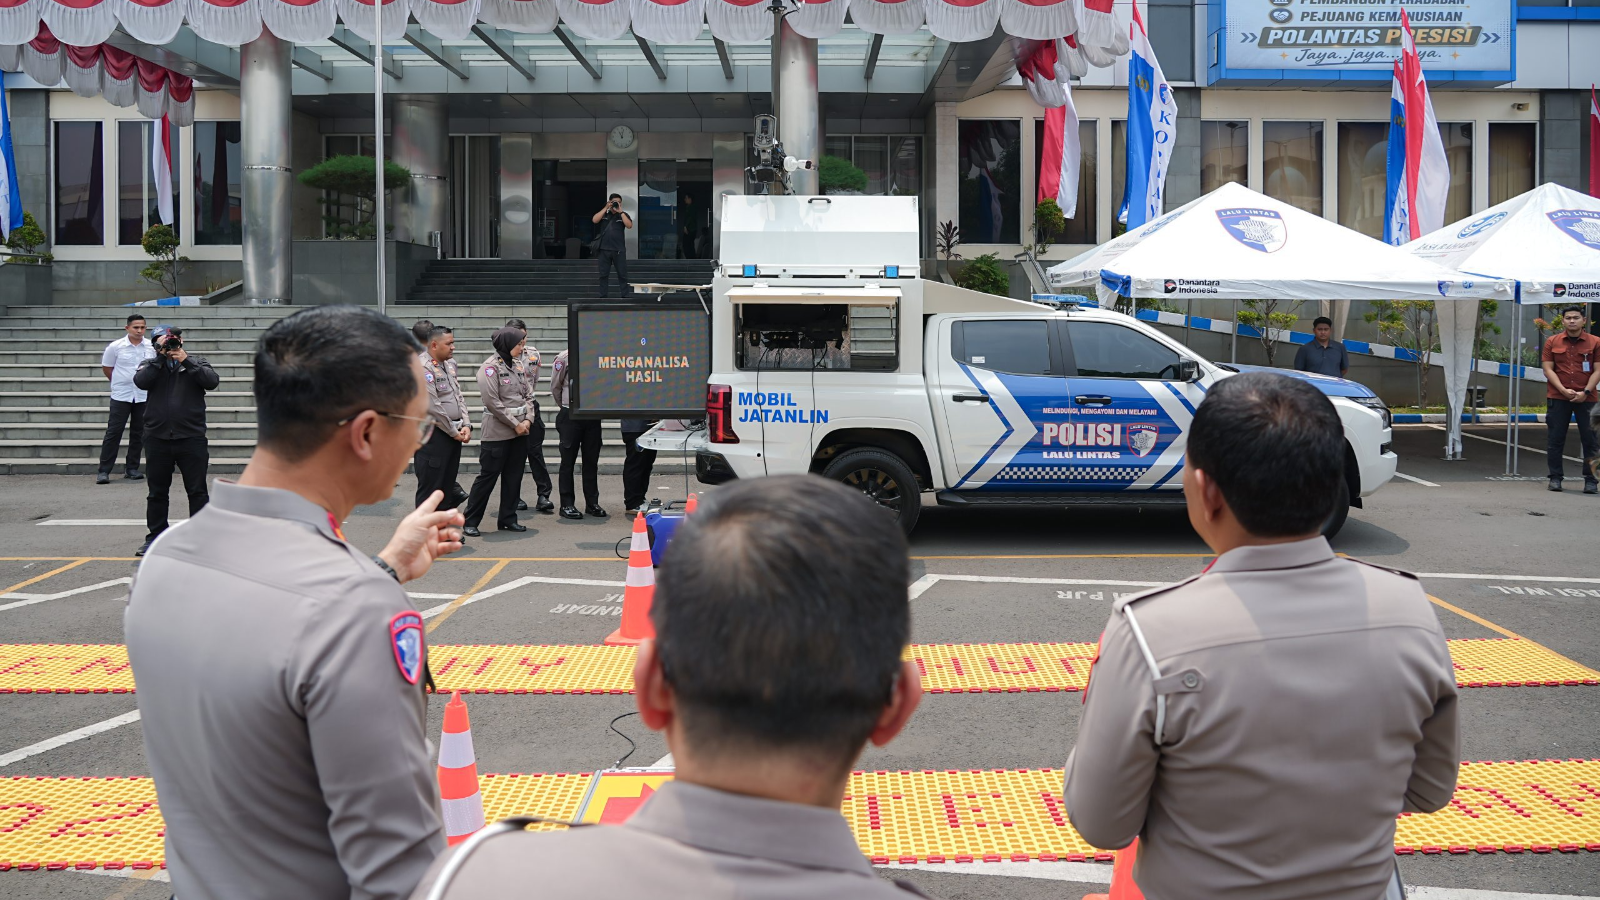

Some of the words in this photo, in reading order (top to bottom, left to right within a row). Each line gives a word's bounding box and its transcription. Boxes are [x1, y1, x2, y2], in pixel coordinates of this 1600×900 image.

[1300, 12, 1364, 21] PEJUANG
[1267, 29, 1381, 44] POLANTAS
[598, 356, 690, 368] MENGANALISA
[626, 371, 662, 382] HASIL
[738, 392, 797, 406] MOBIL
[738, 409, 829, 423] JATANLIN
[1043, 423, 1121, 446] POLISI
[1056, 591, 1103, 600] PJR
[1488, 586, 1554, 595] WAL
